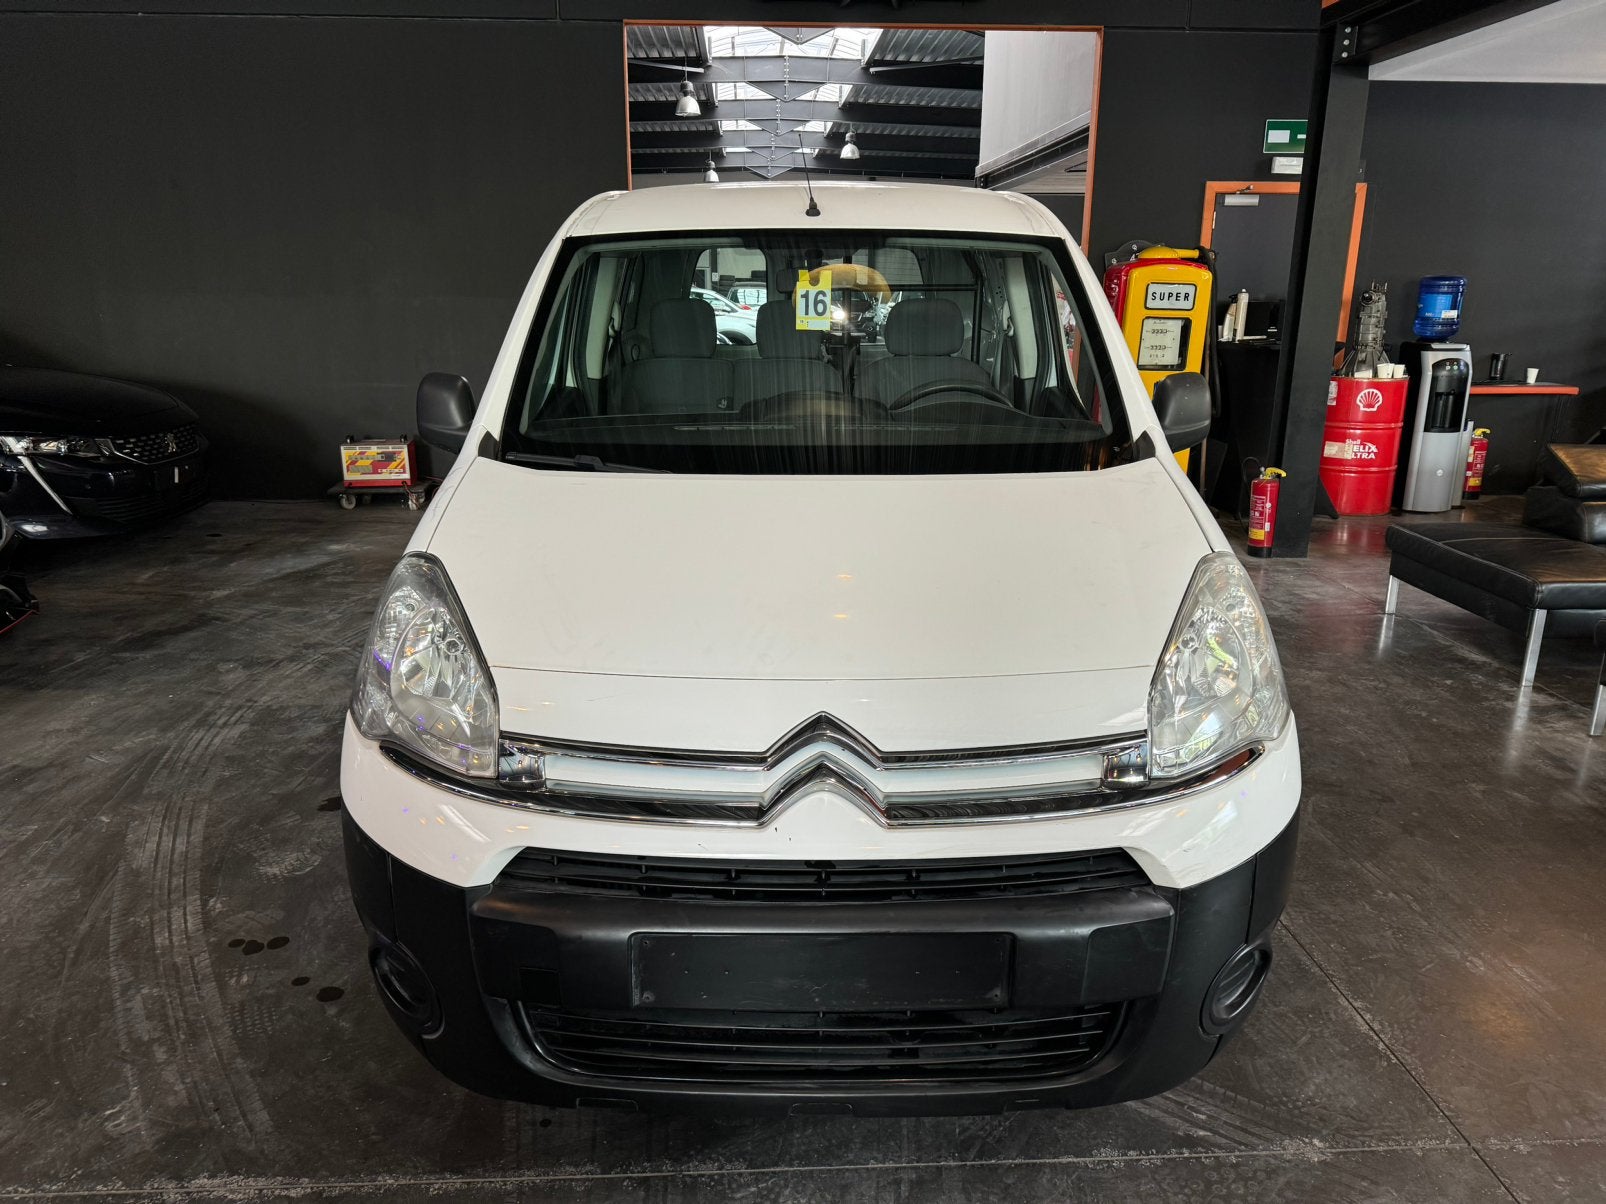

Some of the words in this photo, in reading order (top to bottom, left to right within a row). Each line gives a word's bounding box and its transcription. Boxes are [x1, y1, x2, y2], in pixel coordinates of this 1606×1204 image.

[1151, 291, 1190, 302] SUPER
[801, 290, 827, 316] 16
[1353, 442, 1379, 453] ELIX
